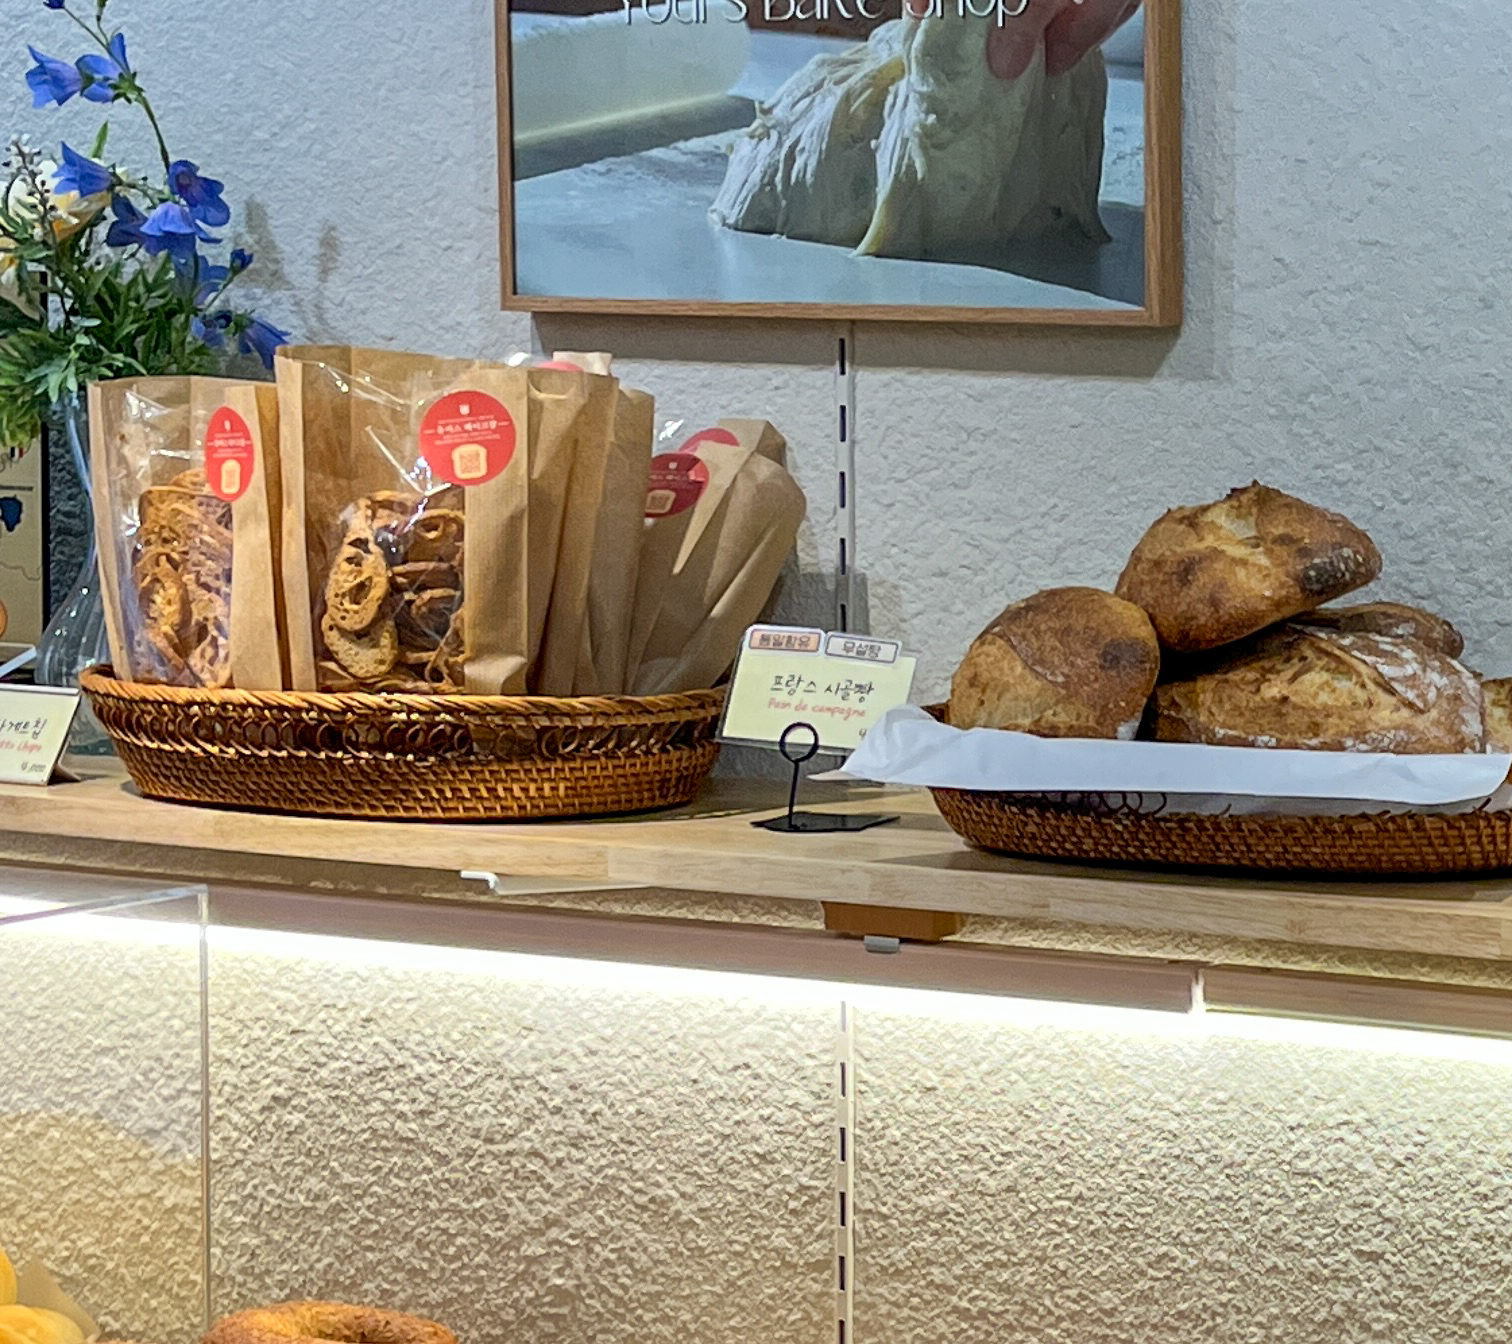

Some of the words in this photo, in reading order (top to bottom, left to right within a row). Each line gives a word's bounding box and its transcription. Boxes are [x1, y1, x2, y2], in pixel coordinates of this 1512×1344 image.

[770, 674, 818, 696] 프랑스
[824, 679, 875, 703] 시골빵
[794, 698, 808, 712] de
